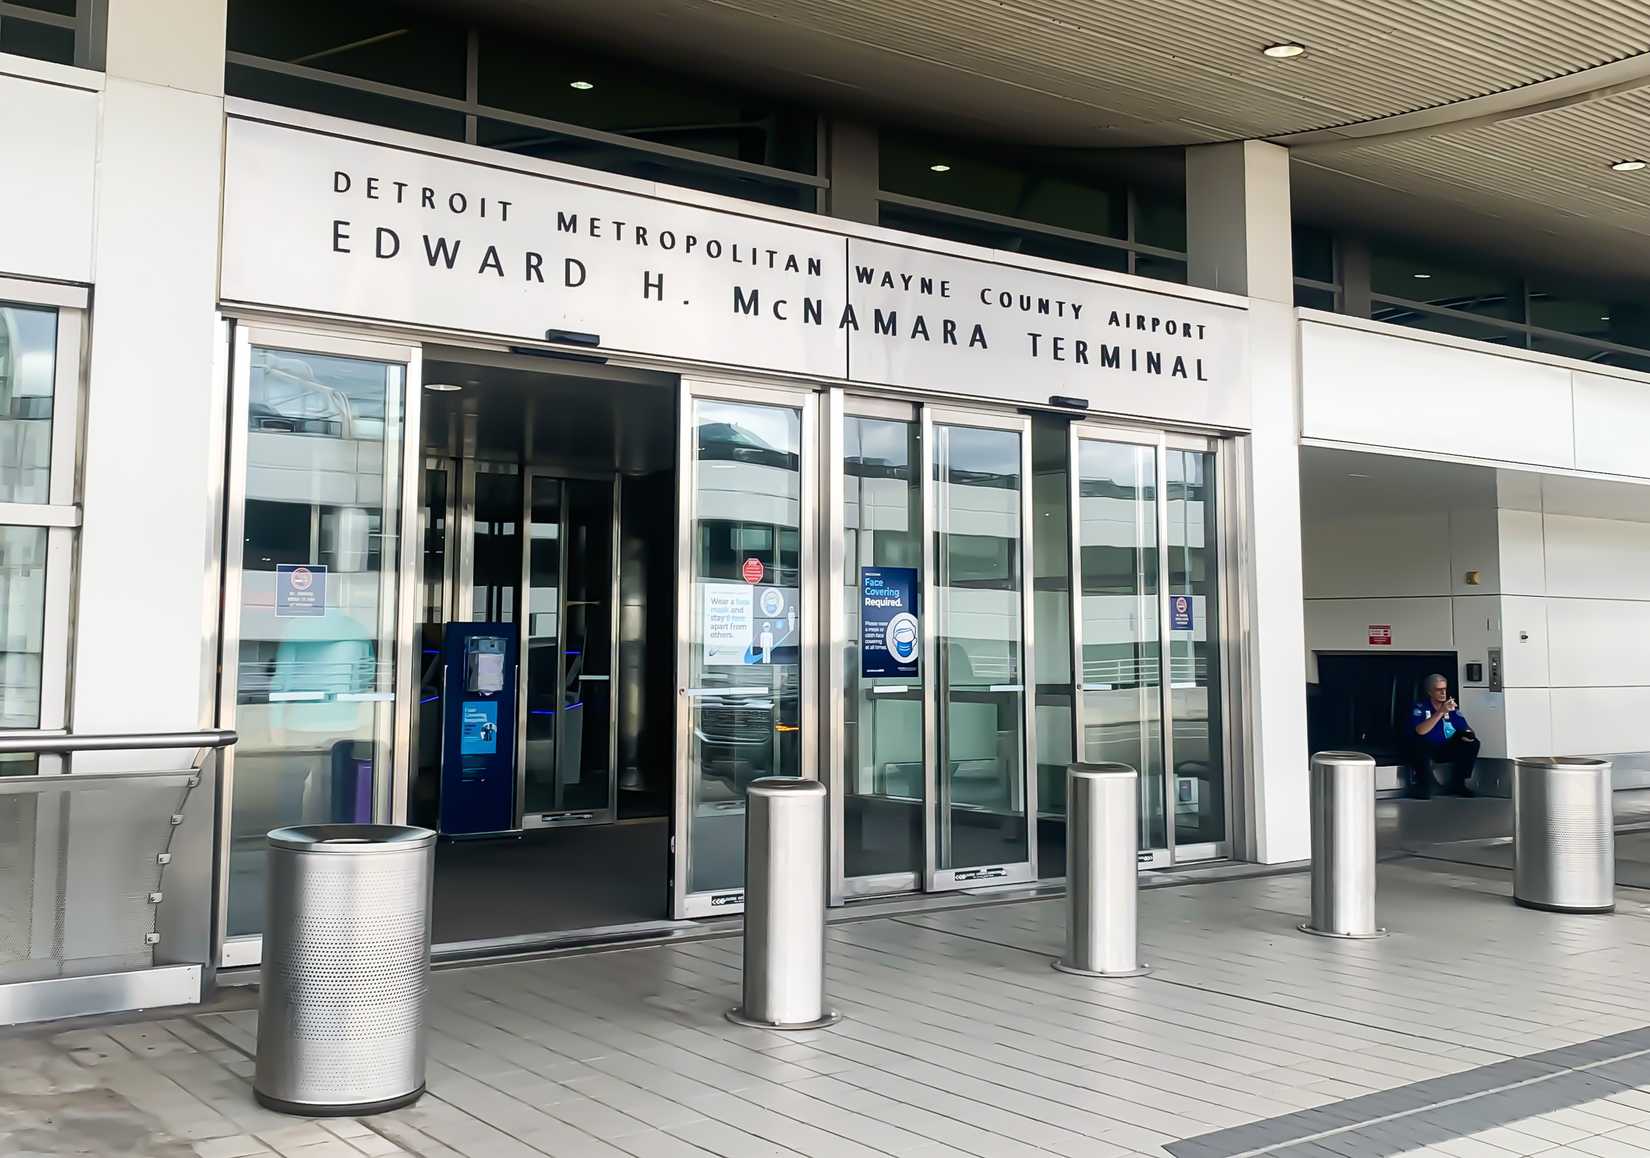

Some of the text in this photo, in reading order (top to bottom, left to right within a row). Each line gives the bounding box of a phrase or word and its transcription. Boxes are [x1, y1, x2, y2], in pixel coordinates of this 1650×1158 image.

[333, 171, 1206, 340] DETROIT METROPOLITAN WAYNE COUNTY AIRPORT
[333, 220, 1210, 382] EDWARD H. McNAMARA TERMINAL
[864, 577, 884, 587] Face
[864, 586, 901, 599] Covering
[710, 597, 729, 605] Wear
[864, 597, 903, 608] Required.
[710, 622, 748, 631] apart from
